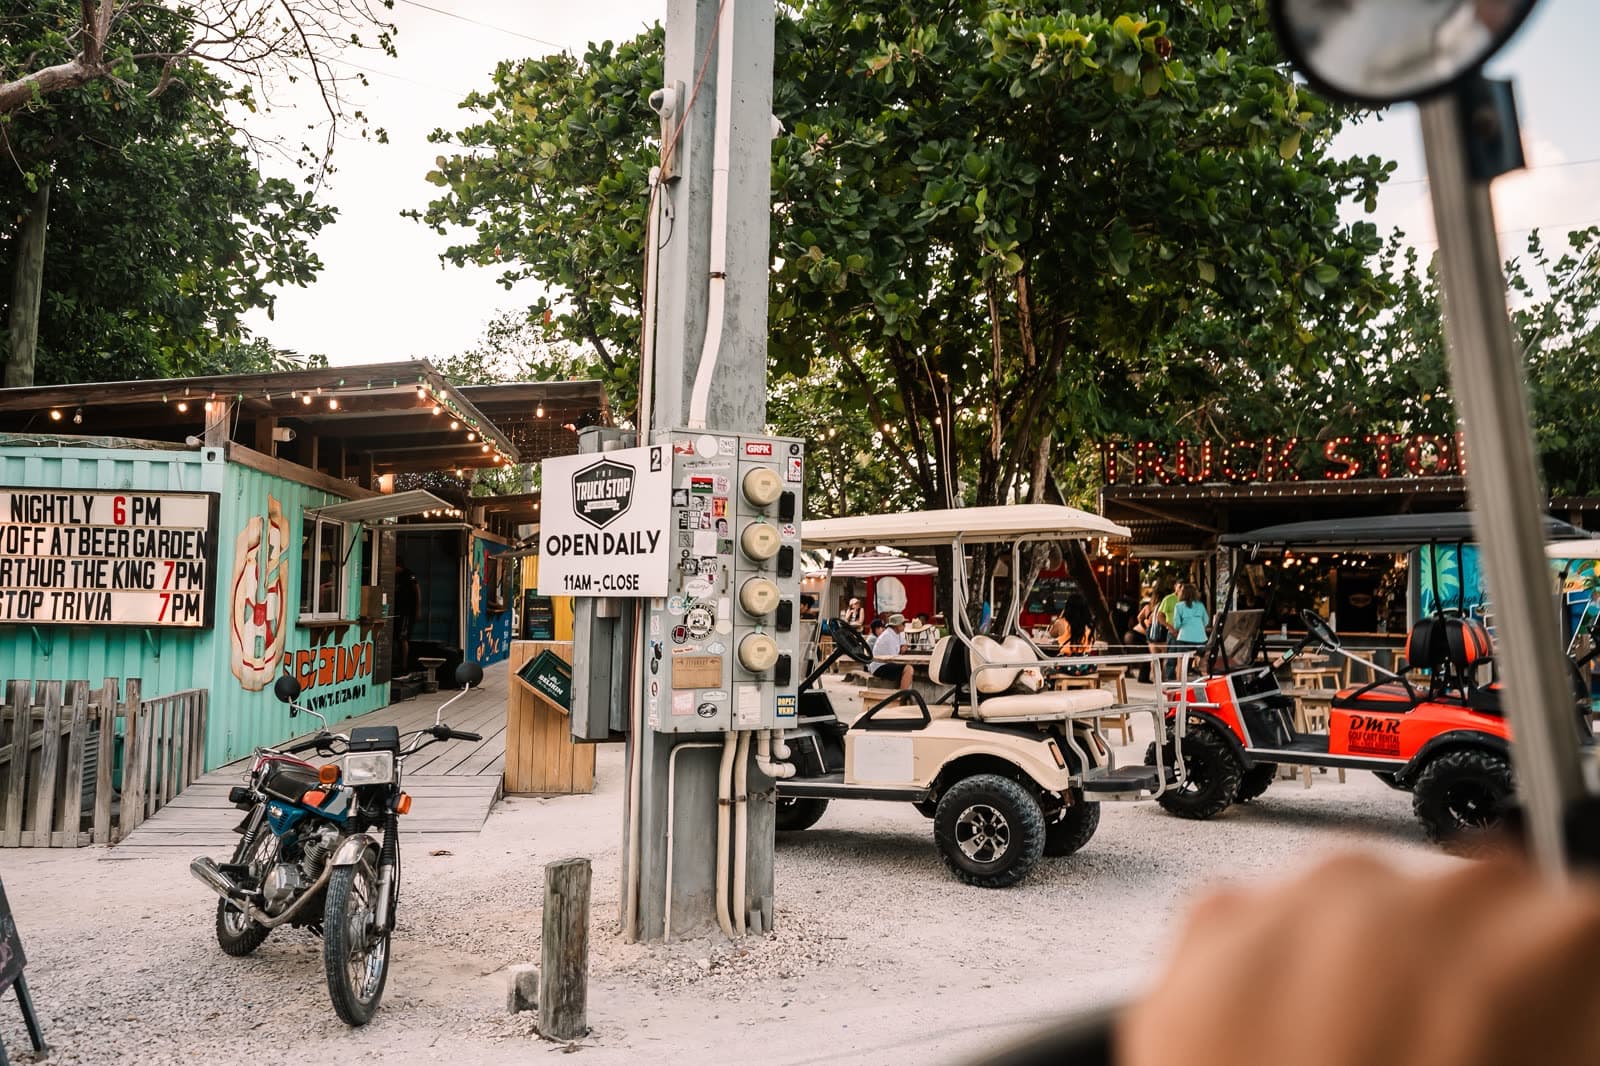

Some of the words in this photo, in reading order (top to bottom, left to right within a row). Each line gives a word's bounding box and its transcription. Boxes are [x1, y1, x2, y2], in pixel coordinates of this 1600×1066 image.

[650, 448, 661, 471] 2
[1094, 437, 1300, 485] TRUCK
[1325, 432, 1467, 481] STO
[576, 480, 606, 501] TRUCK
[606, 477, 631, 498] STOP
[11, 494, 94, 524] NIGHTLY
[51, 527, 75, 556] AT
[78, 528, 130, 557] BEER
[133, 530, 208, 559] GARDEN
[546, 533, 599, 557] OPEN
[603, 530, 662, 556] DAILY
[71, 560, 109, 589] THE
[112, 561, 155, 590] KING
[563, 574, 592, 591] 11AM
[602, 574, 640, 591] CLOSE
[51, 592, 111, 621] TRIVIA
[1349, 714, 1401, 735] DMR
[1363, 732, 1378, 742] CART
[1379, 734, 1400, 744] RENTAL
